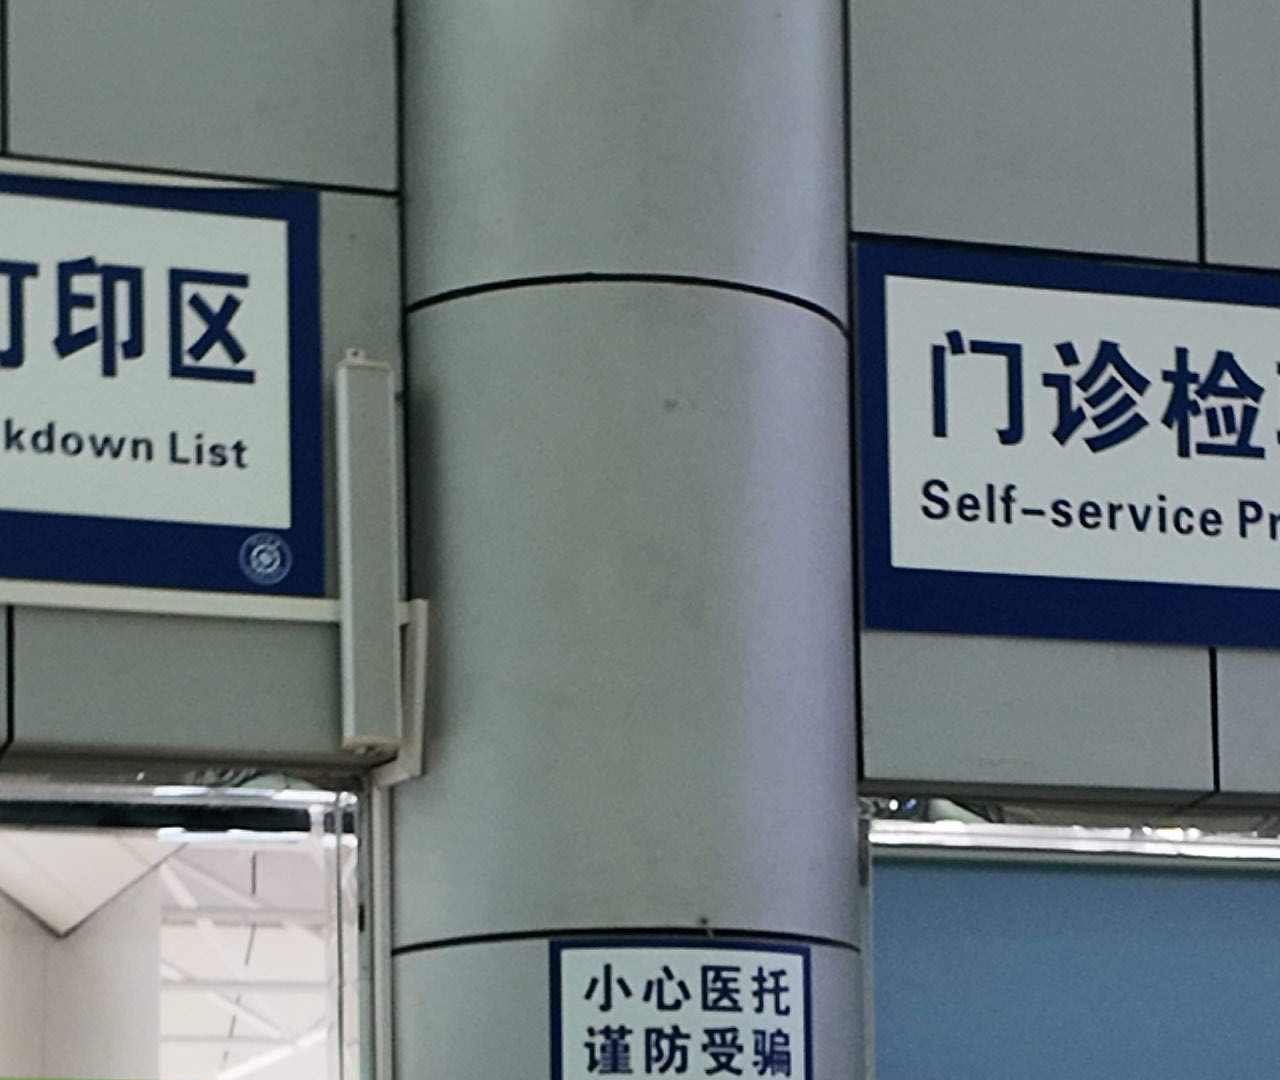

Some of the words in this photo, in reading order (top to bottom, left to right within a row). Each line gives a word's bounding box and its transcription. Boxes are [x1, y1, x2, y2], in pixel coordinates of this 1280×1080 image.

[170, 432, 247, 469] List
[922, 479, 1222, 536] Self-service
[585, 963, 791, 1016] 小心医托
[584, 1025, 792, 1077] 谨防受骗
